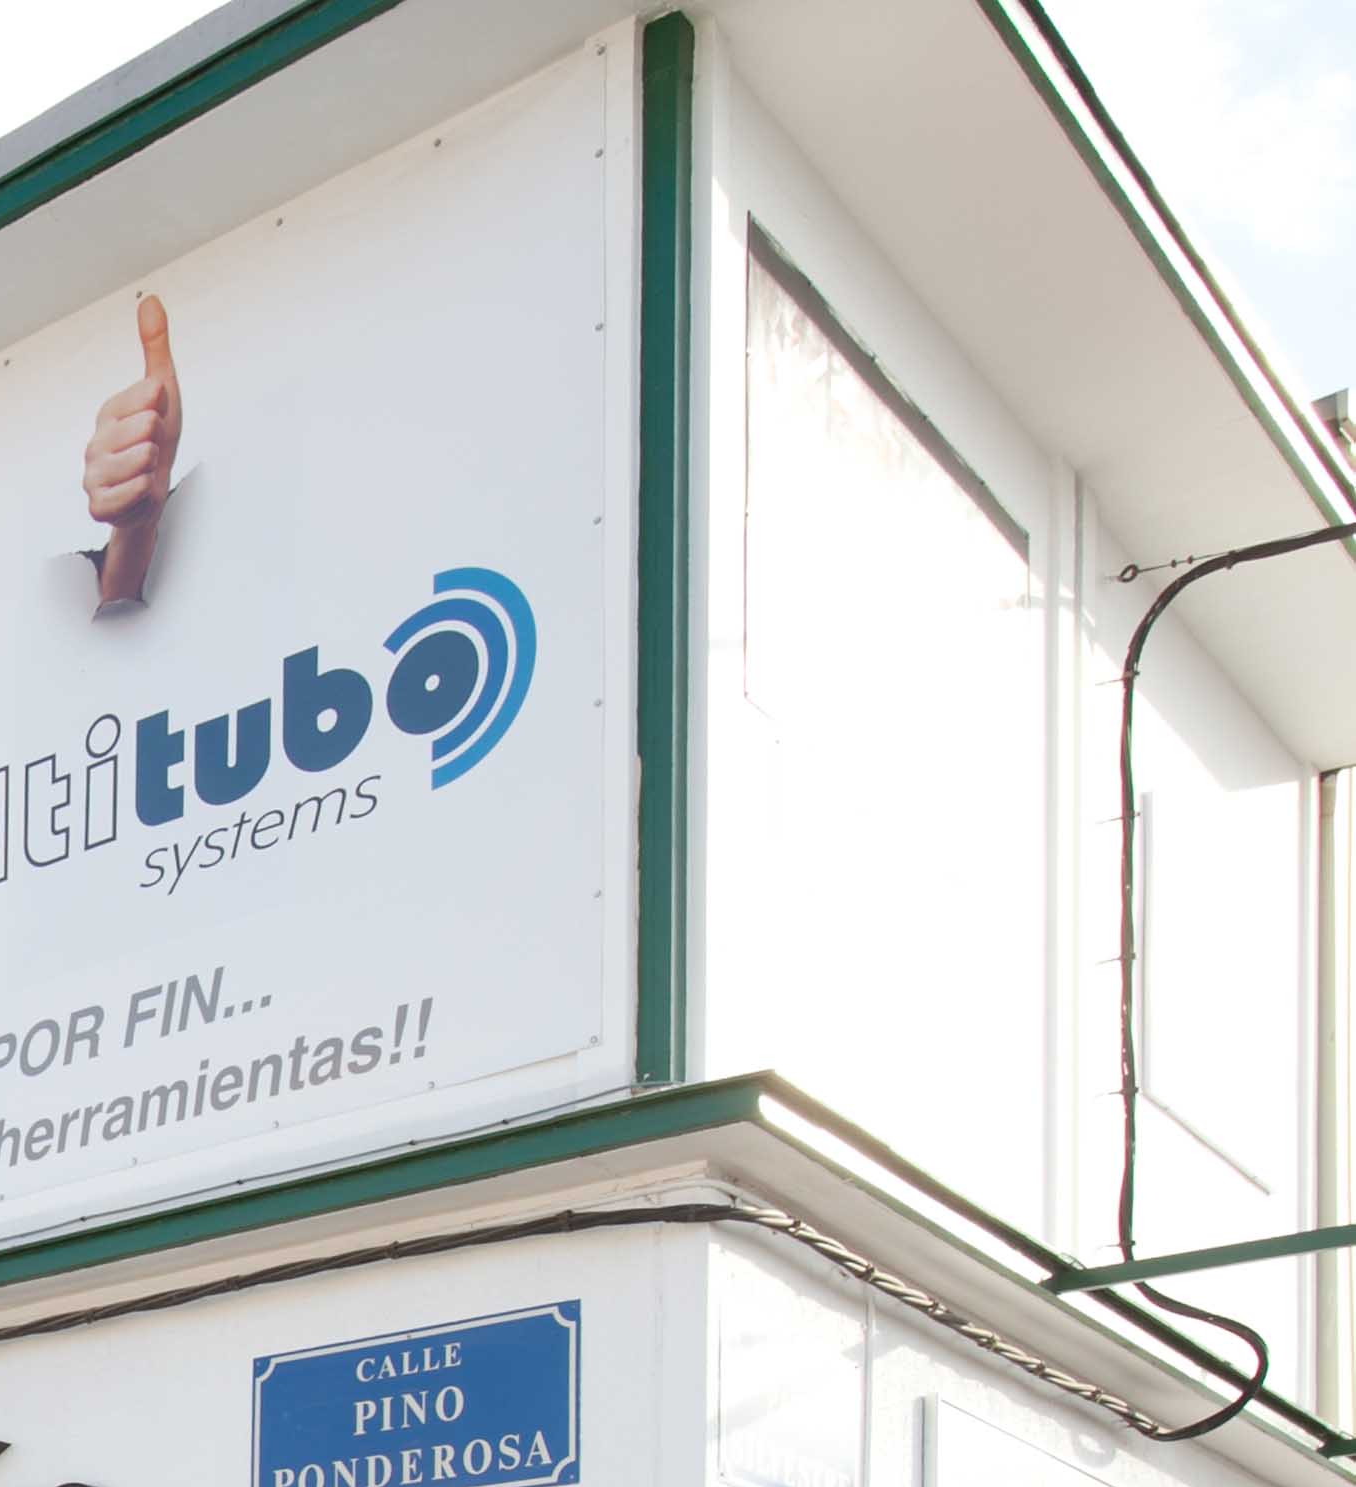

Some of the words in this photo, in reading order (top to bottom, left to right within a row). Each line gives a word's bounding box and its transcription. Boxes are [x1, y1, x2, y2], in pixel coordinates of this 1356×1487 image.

[139, 774, 381, 896] systems
[122, 966, 273, 1050] FIN...
[356, 1342, 463, 1383] CALLE
[353, 1385, 465, 1436] PINO
